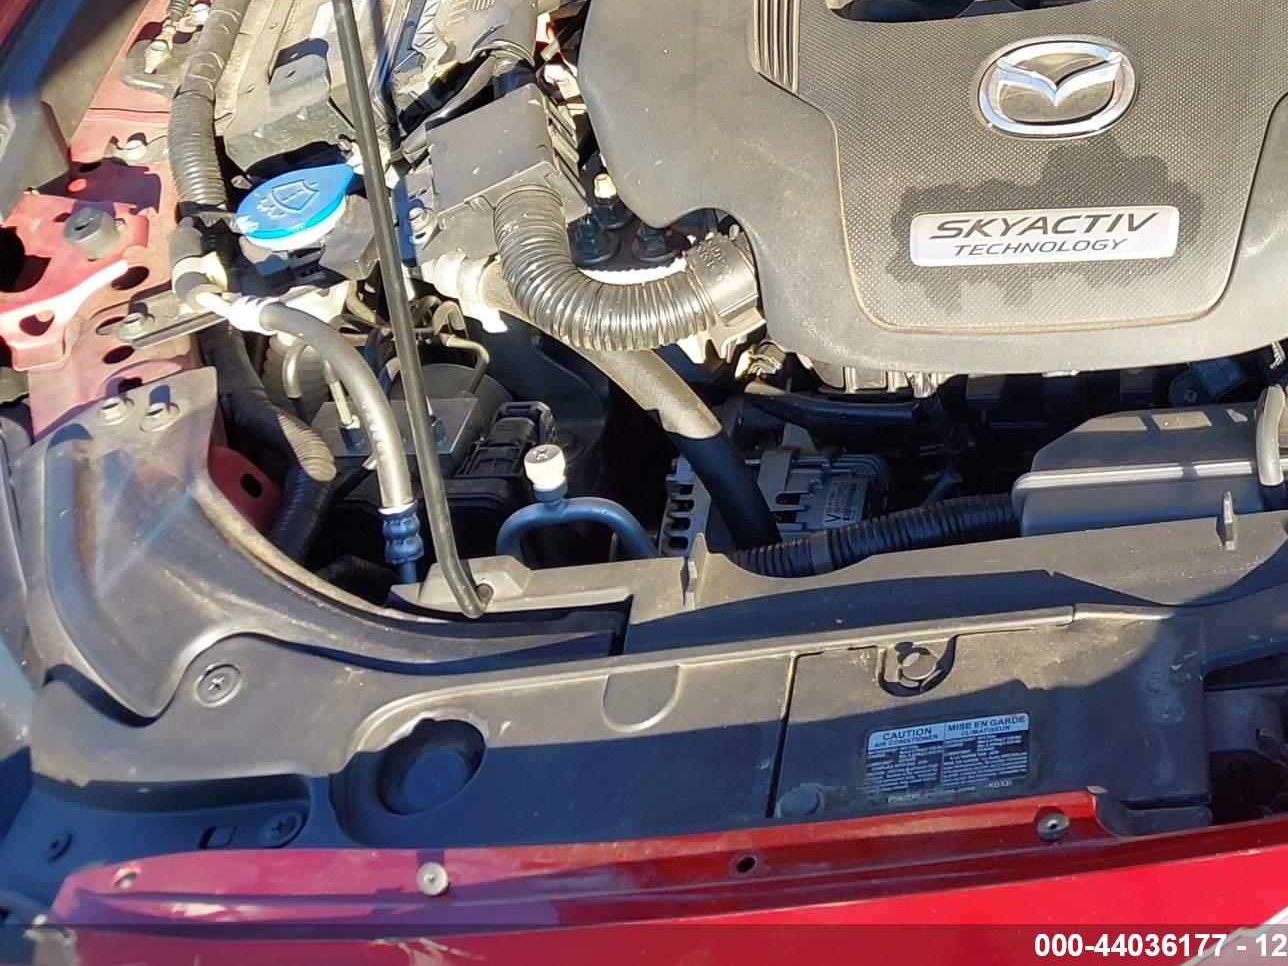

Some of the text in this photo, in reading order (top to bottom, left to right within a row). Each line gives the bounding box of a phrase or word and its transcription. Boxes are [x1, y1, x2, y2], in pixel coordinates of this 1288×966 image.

[929, 212, 1158, 239] SKYACTIV
[954, 238, 1128, 256] TECHNOLOGY
[947, 715, 1026, 732] MISE EN GARDE
[882, 727, 932, 741] CAUTION
[888, 734, 938, 745] CONDITIONER
